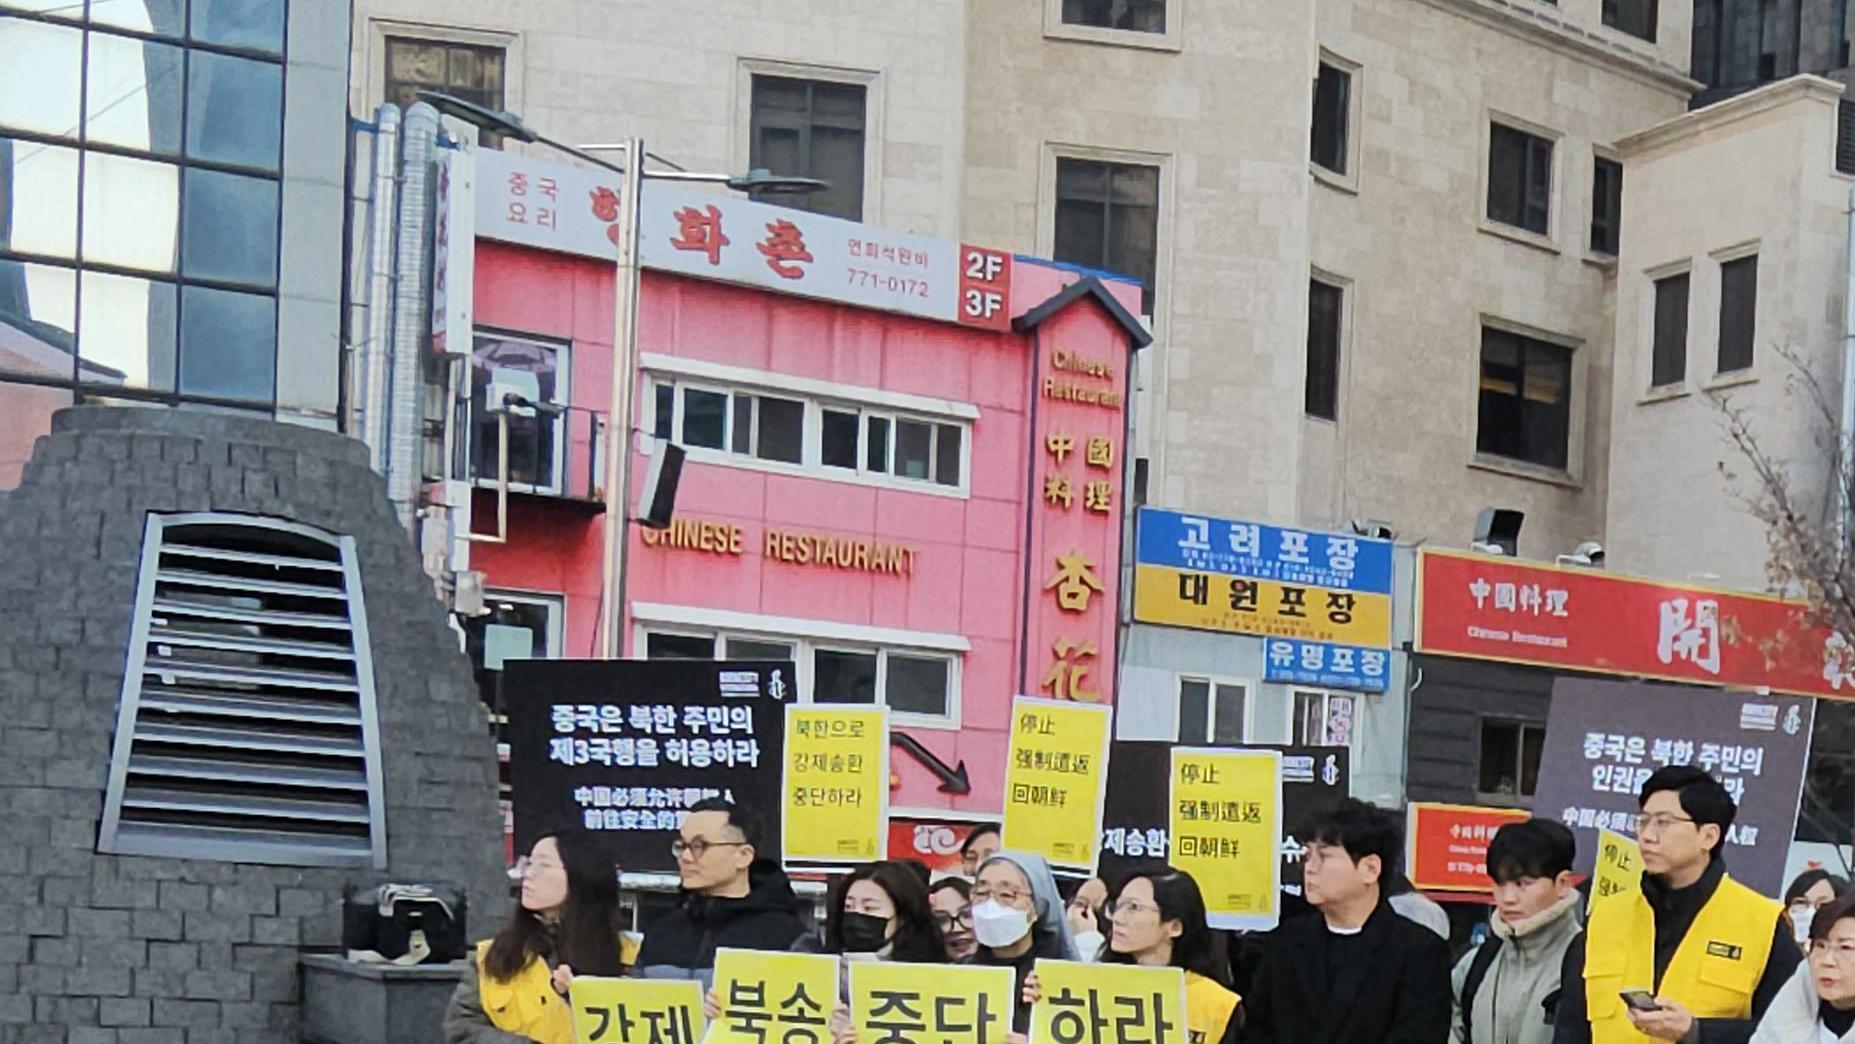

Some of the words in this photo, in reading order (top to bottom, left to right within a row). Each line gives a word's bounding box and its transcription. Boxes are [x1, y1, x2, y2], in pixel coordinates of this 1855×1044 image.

[509, 172, 557, 202] 중국
[507, 202, 557, 231] 요리
[966, 252, 1003, 281] 2F
[847, 267, 929, 298] 771-0172
[965, 288, 1002, 318] 3F
[1047, 427, 1115, 470] 中國
[764, 530, 918, 580] RESTAURANT
[1178, 516, 1359, 570] 고려포장
[1178, 574, 1356, 624] 대원포장
[1269, 641, 1386, 676] 유명포장
[551, 703, 624, 734] 중국은
[629, 704, 678, 735] 북한
[683, 704, 753, 735] 주민의
[796, 719, 865, 739] 북한으로
[1020, 712, 1056, 736] 停止
[664, 738, 761, 768] 허용하라
[794, 752, 863, 774] 강제송환
[1584, 732, 1646, 764] 중국은
[1651, 739, 1694, 767] 북한
[1698, 740, 1764, 776] 주민의
[1180, 762, 1221, 785] 停止
[792, 786, 862, 808] 중단하라
